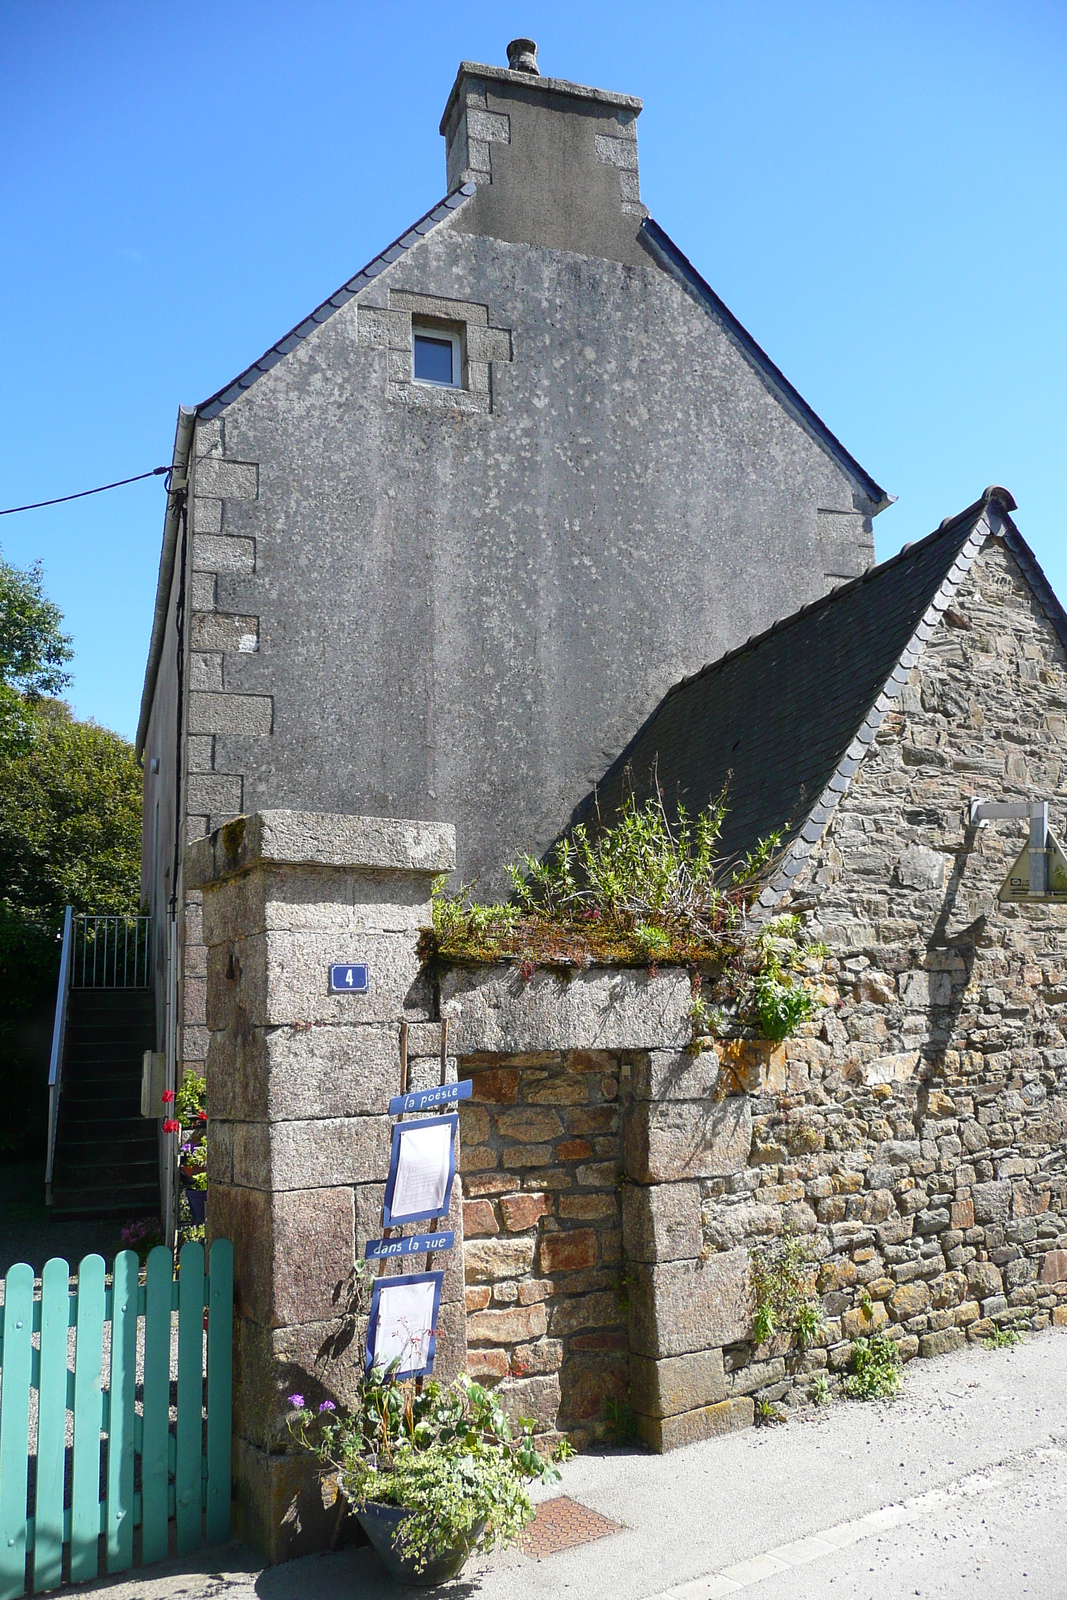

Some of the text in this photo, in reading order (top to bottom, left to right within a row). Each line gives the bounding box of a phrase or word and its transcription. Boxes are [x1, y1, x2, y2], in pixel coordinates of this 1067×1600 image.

[345, 968, 354, 986] 4
[404, 1087, 458, 1110] la poésie
[373, 1237, 447, 1255] dans la rue
